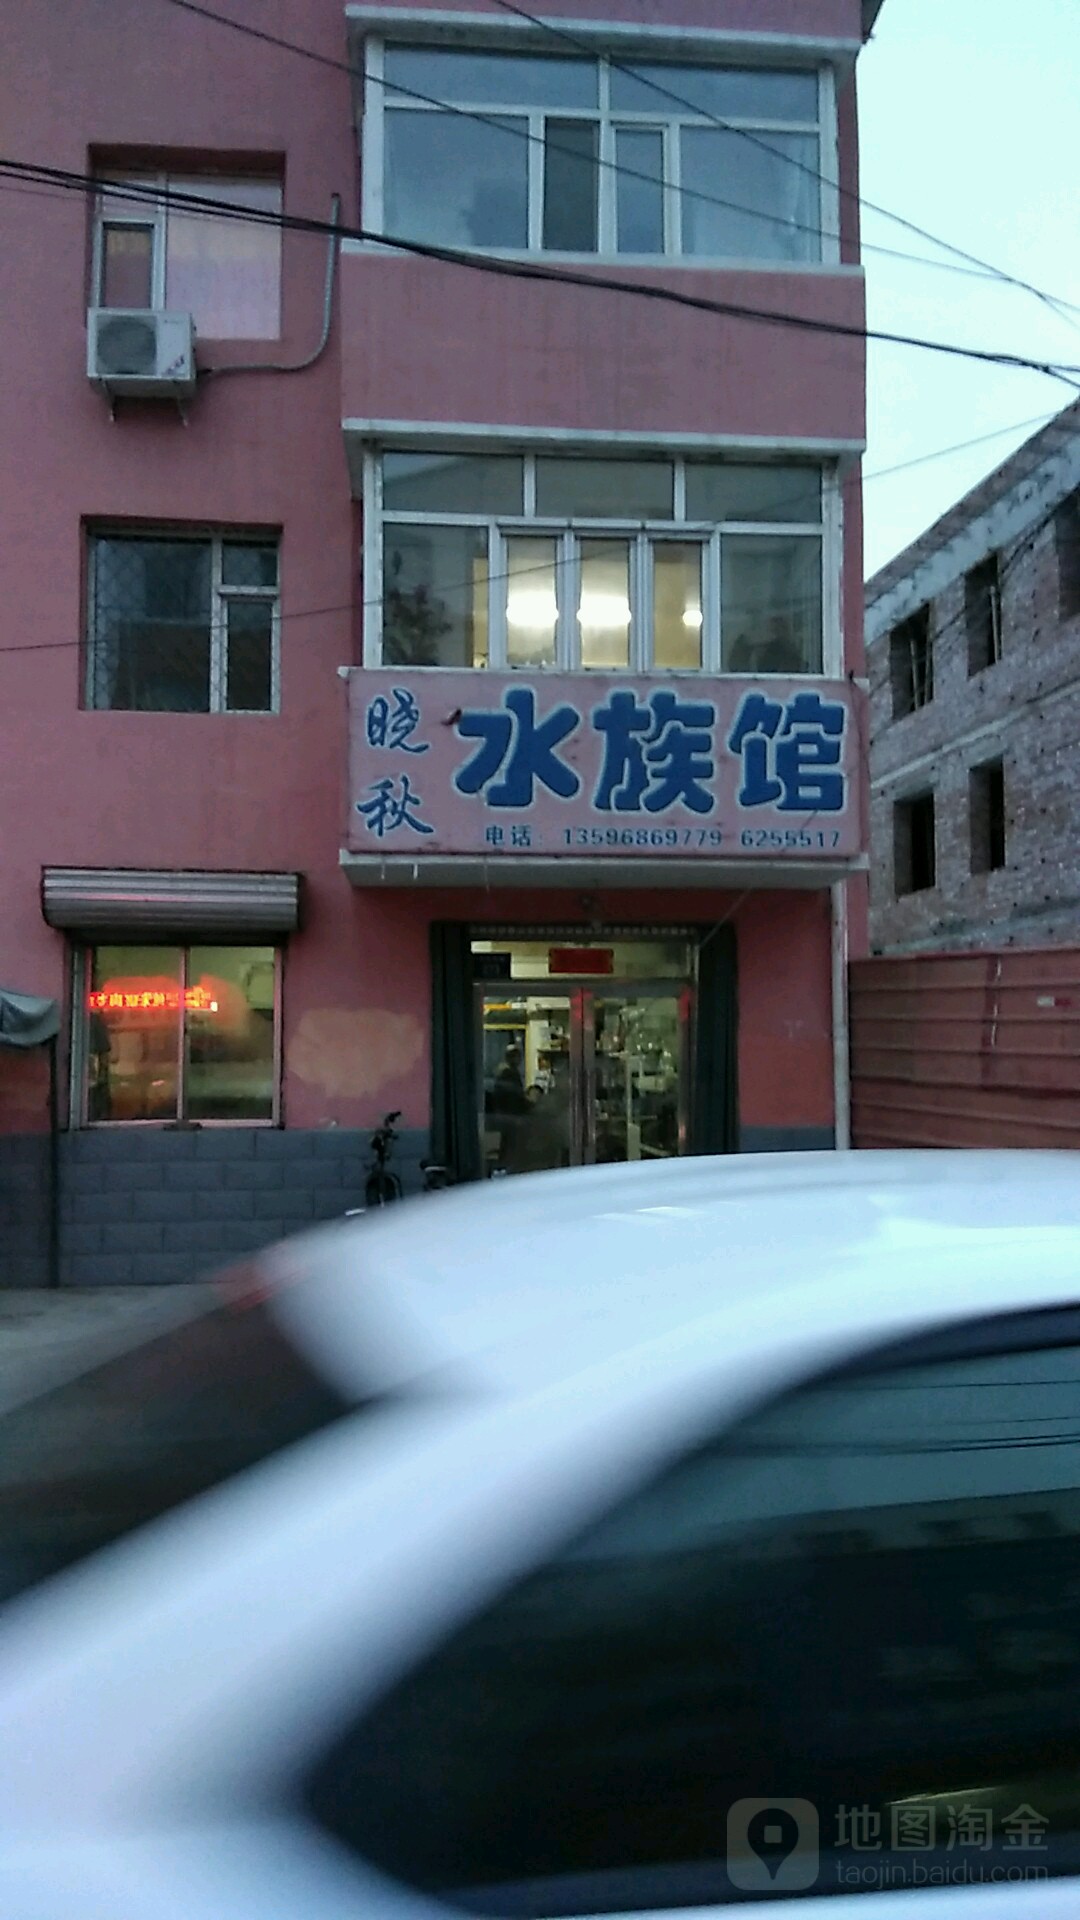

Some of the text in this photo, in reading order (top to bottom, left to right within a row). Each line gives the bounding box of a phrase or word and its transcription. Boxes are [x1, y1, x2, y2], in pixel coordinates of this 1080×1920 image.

[357, 687, 434, 837] 晓秋
[454, 686, 846, 814] 水族馆
[563, 828, 722, 847] 13596869779
[740, 830, 840, 848] 6255517
